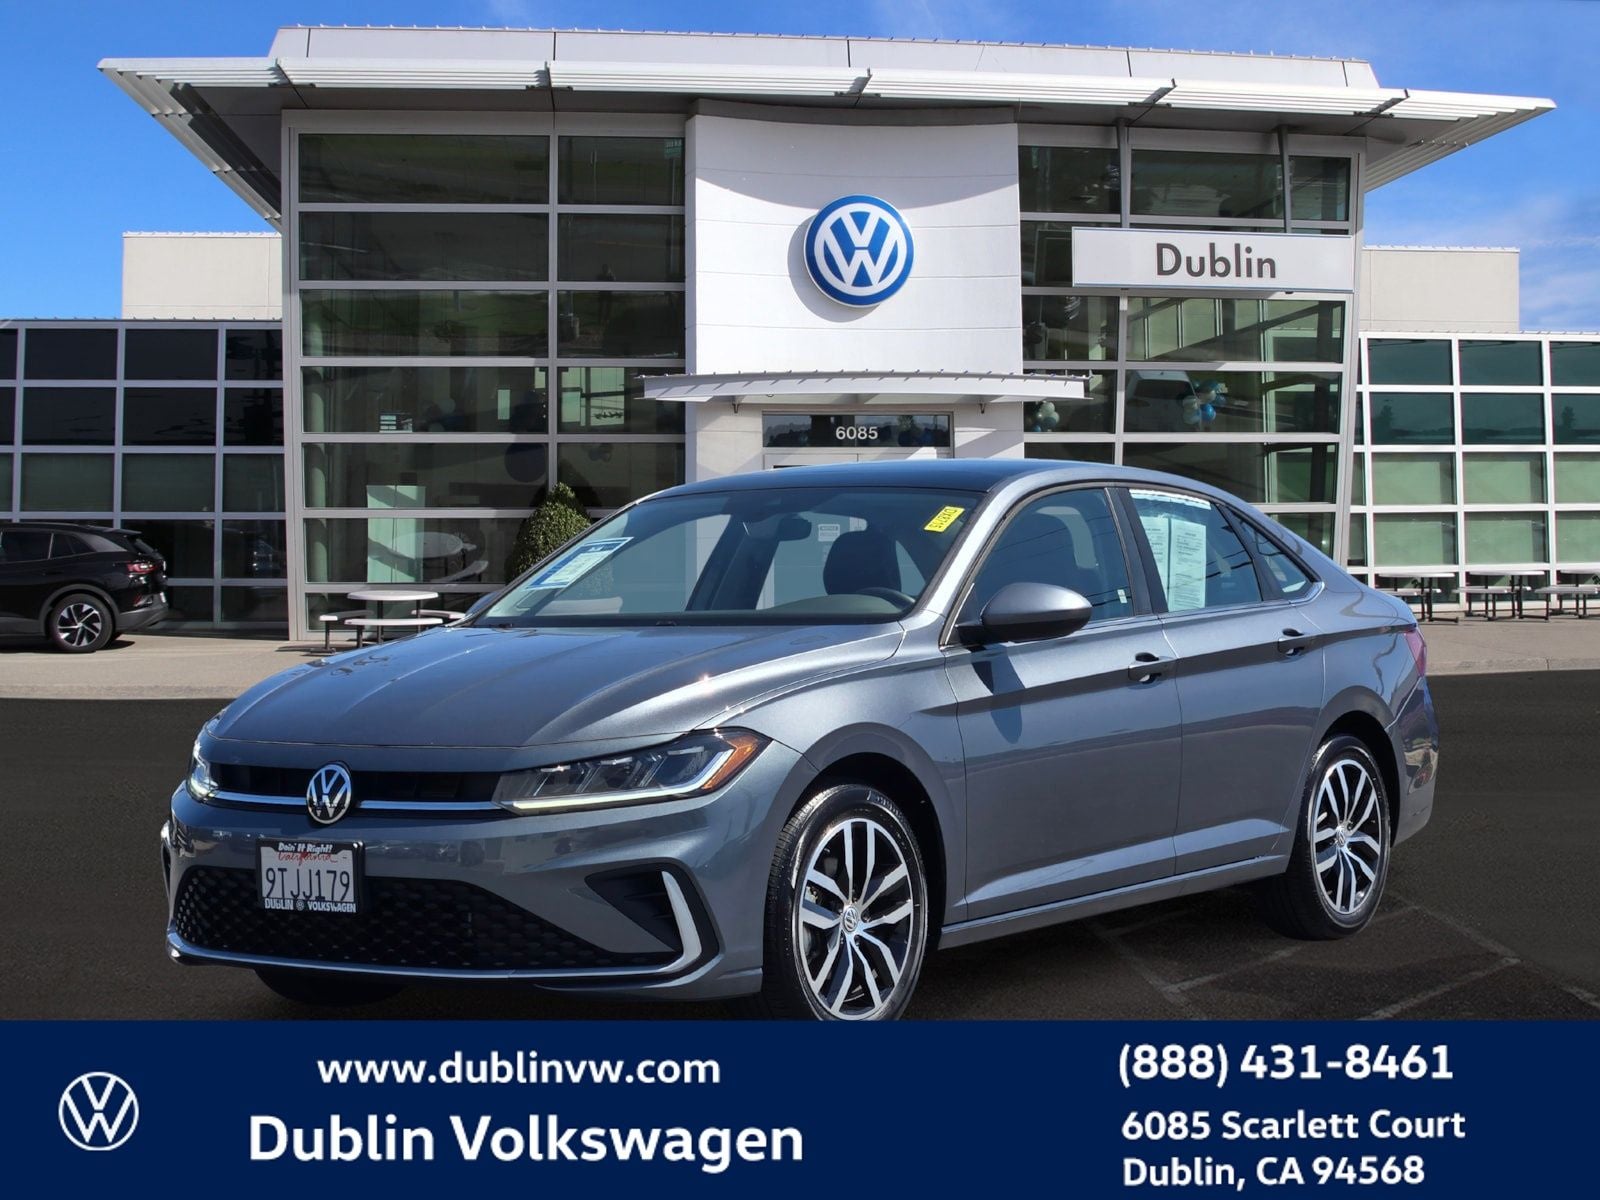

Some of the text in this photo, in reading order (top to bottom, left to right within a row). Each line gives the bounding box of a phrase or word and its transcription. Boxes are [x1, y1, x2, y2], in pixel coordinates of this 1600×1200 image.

[813, 202, 908, 297] VW
[1156, 242, 1276, 278] Dublin
[835, 426, 878, 440] 6085
[307, 764, 351, 824] VW
[265, 867, 350, 902] 9TJJ179
[264, 898, 356, 913] DUBLIN VOLKSWAGEN
